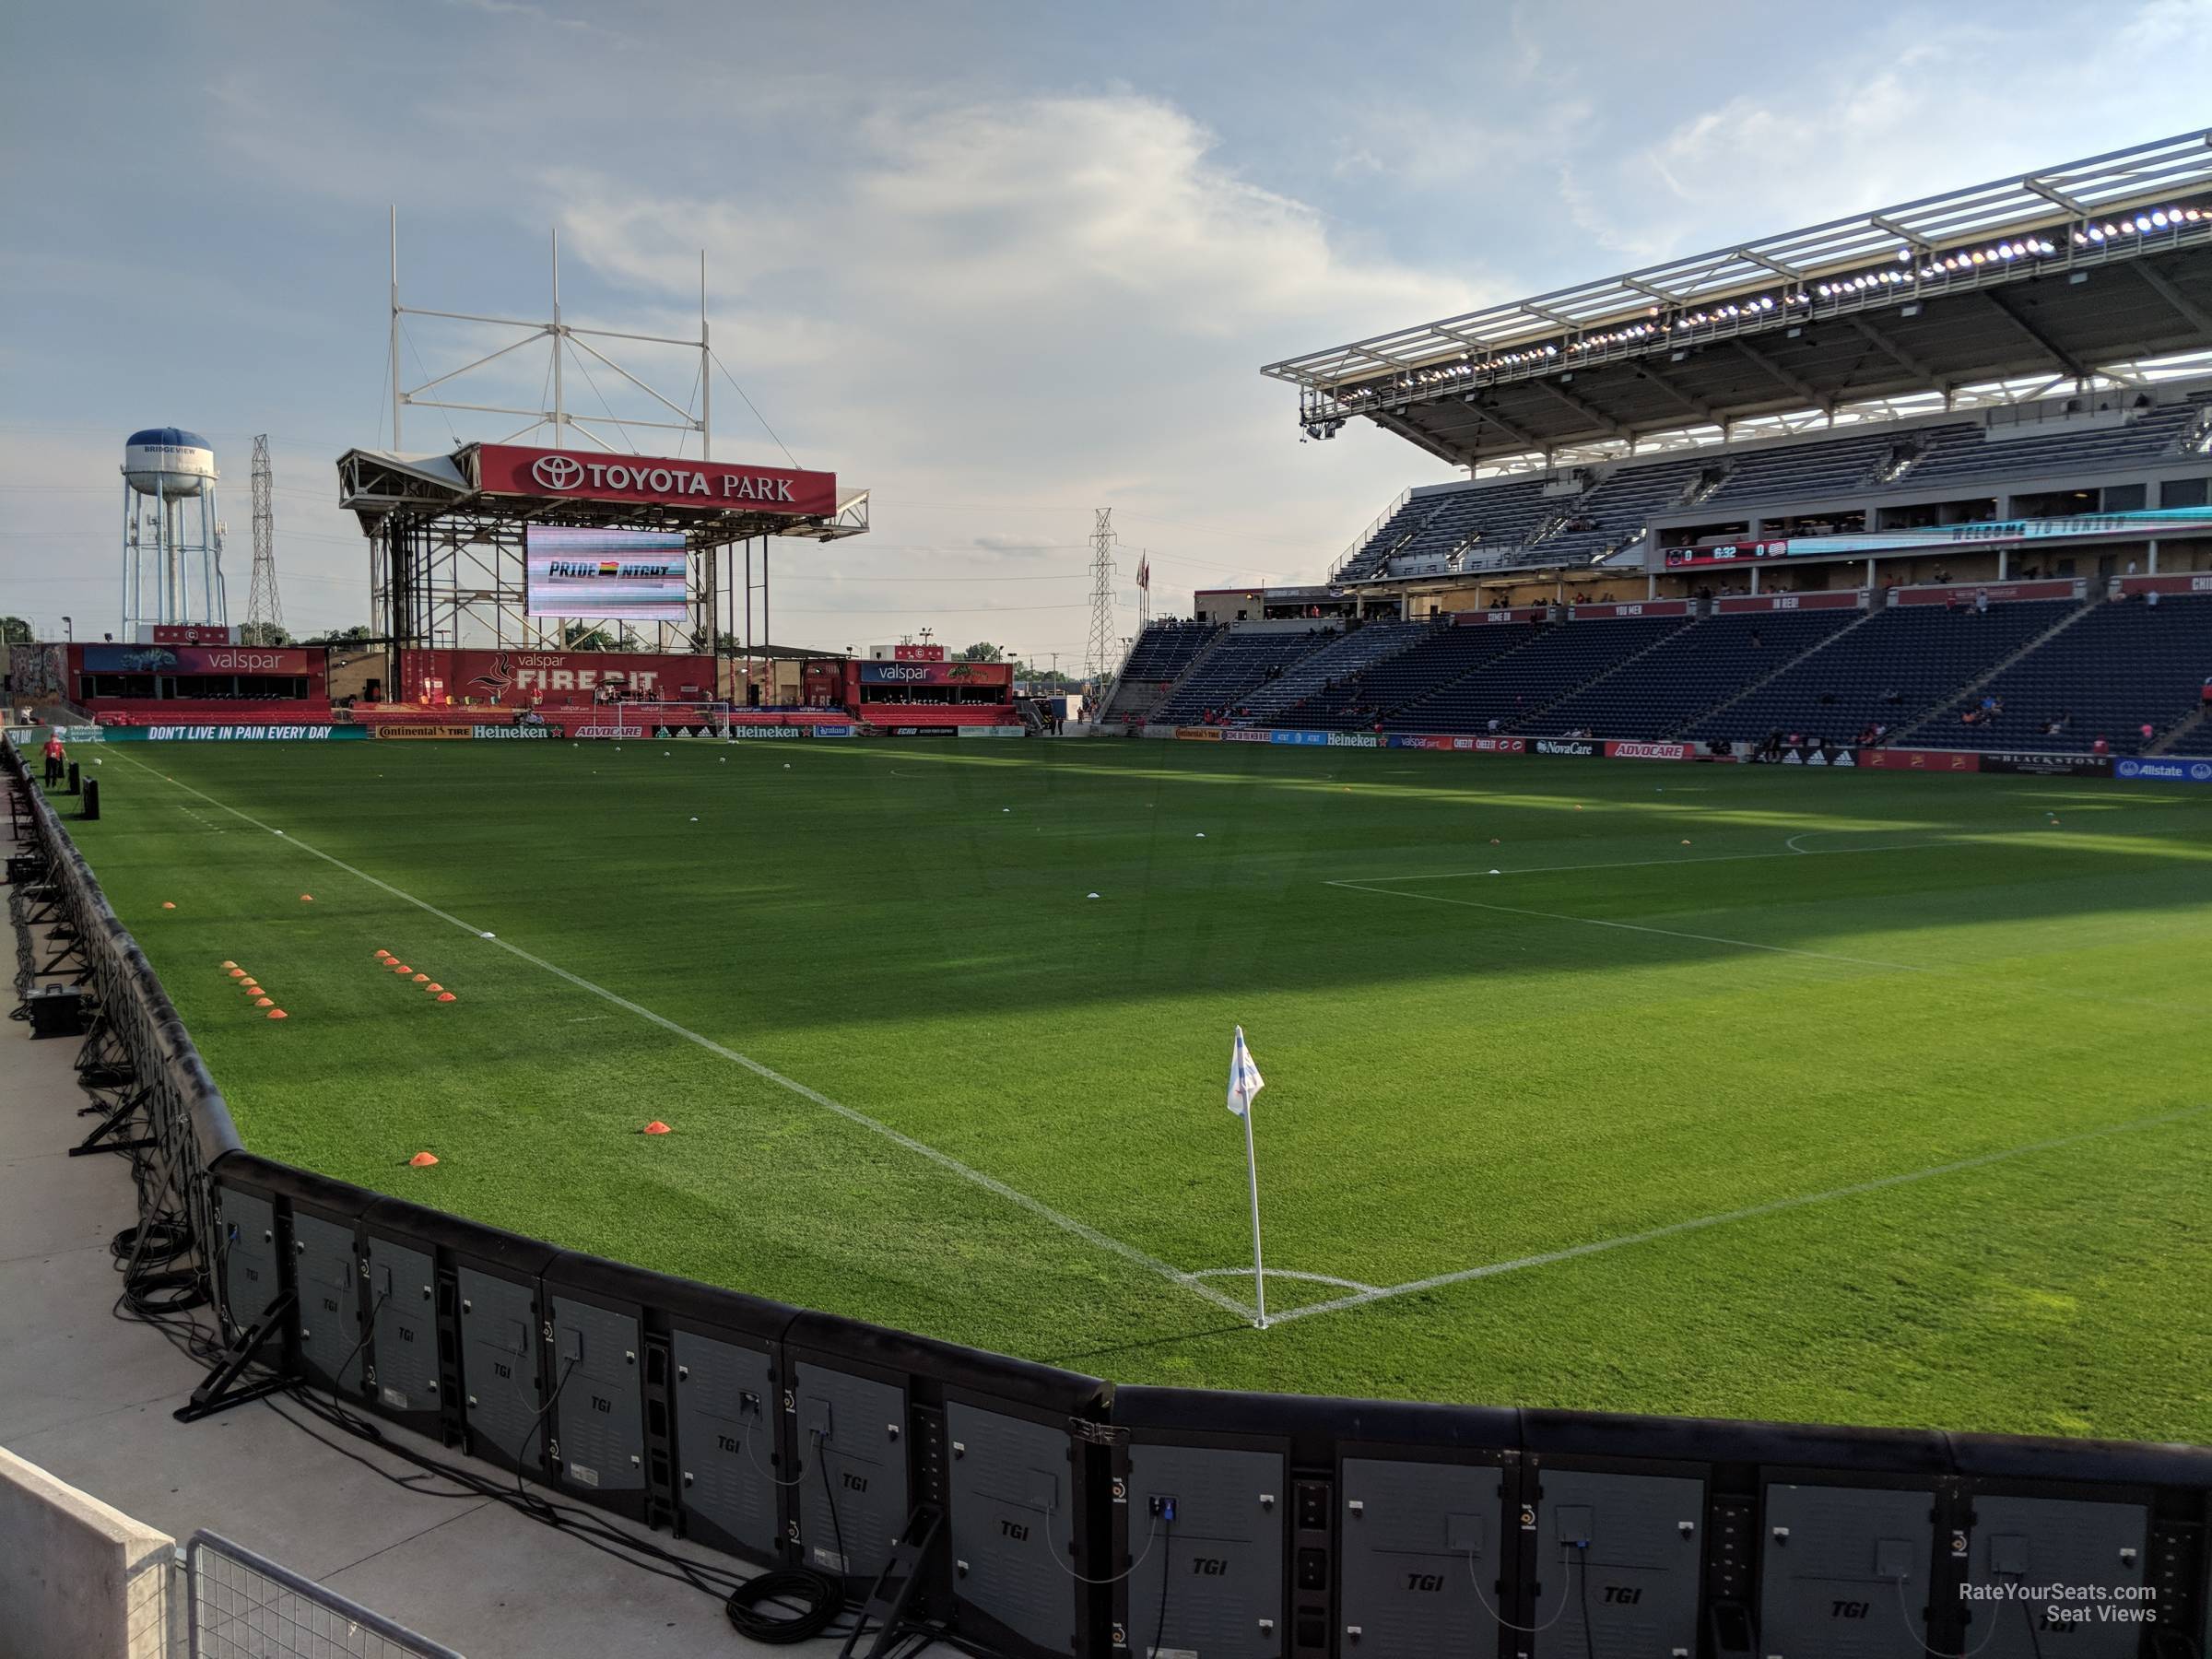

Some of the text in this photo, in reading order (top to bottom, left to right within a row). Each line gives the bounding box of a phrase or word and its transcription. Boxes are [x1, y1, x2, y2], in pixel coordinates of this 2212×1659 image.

[145, 446, 196, 455] BRIDGEVIEW
[587, 463, 795, 502] TOYOTA PARK
[1685, 550, 1692, 561] 0
[1714, 547, 1736, 559] 6:32
[1756, 545, 1764, 556] 0
[549, 561, 596, 578] PRIDE
[209, 650, 285, 673] valspar
[518, 653, 567, 669] valspar
[517, 669, 597, 690] FIRE
[879, 664, 930, 683] valspar
[148, 725, 333, 740] DON'T LIVE IN PAIN EVERY DAY
[379, 726, 437, 738] Continental
[474, 725, 548, 738] Heineken
[575, 726, 642, 737] ADVOCARE
[736, 726, 799, 737] Heineken
[1327, 733, 1377, 747] Heineken
[1401, 737, 1427, 747] valspar
[1546, 741, 1593, 755] NovaCare
[1615, 744, 1684, 759] ADVOCARE
[2002, 755, 2107, 766] BLACKSTONE
[2138, 765, 2183, 777] Allstate
[324, 1298, 337, 1312] TGI
[399, 1327, 414, 1342] TGI
[494, 1362, 511, 1380] TGI
[591, 1395, 612, 1414] TGI
[718, 1435, 740, 1454] TGI
[842, 1473, 867, 1493] TGI
[1001, 1520, 1029, 1542] TGI
[1194, 1558, 1228, 1576] TGI
[1407, 1573, 1443, 1592] TGI
[1604, 1586, 1642, 1605] TGI
[1831, 1600, 1869, 1619] TGI
